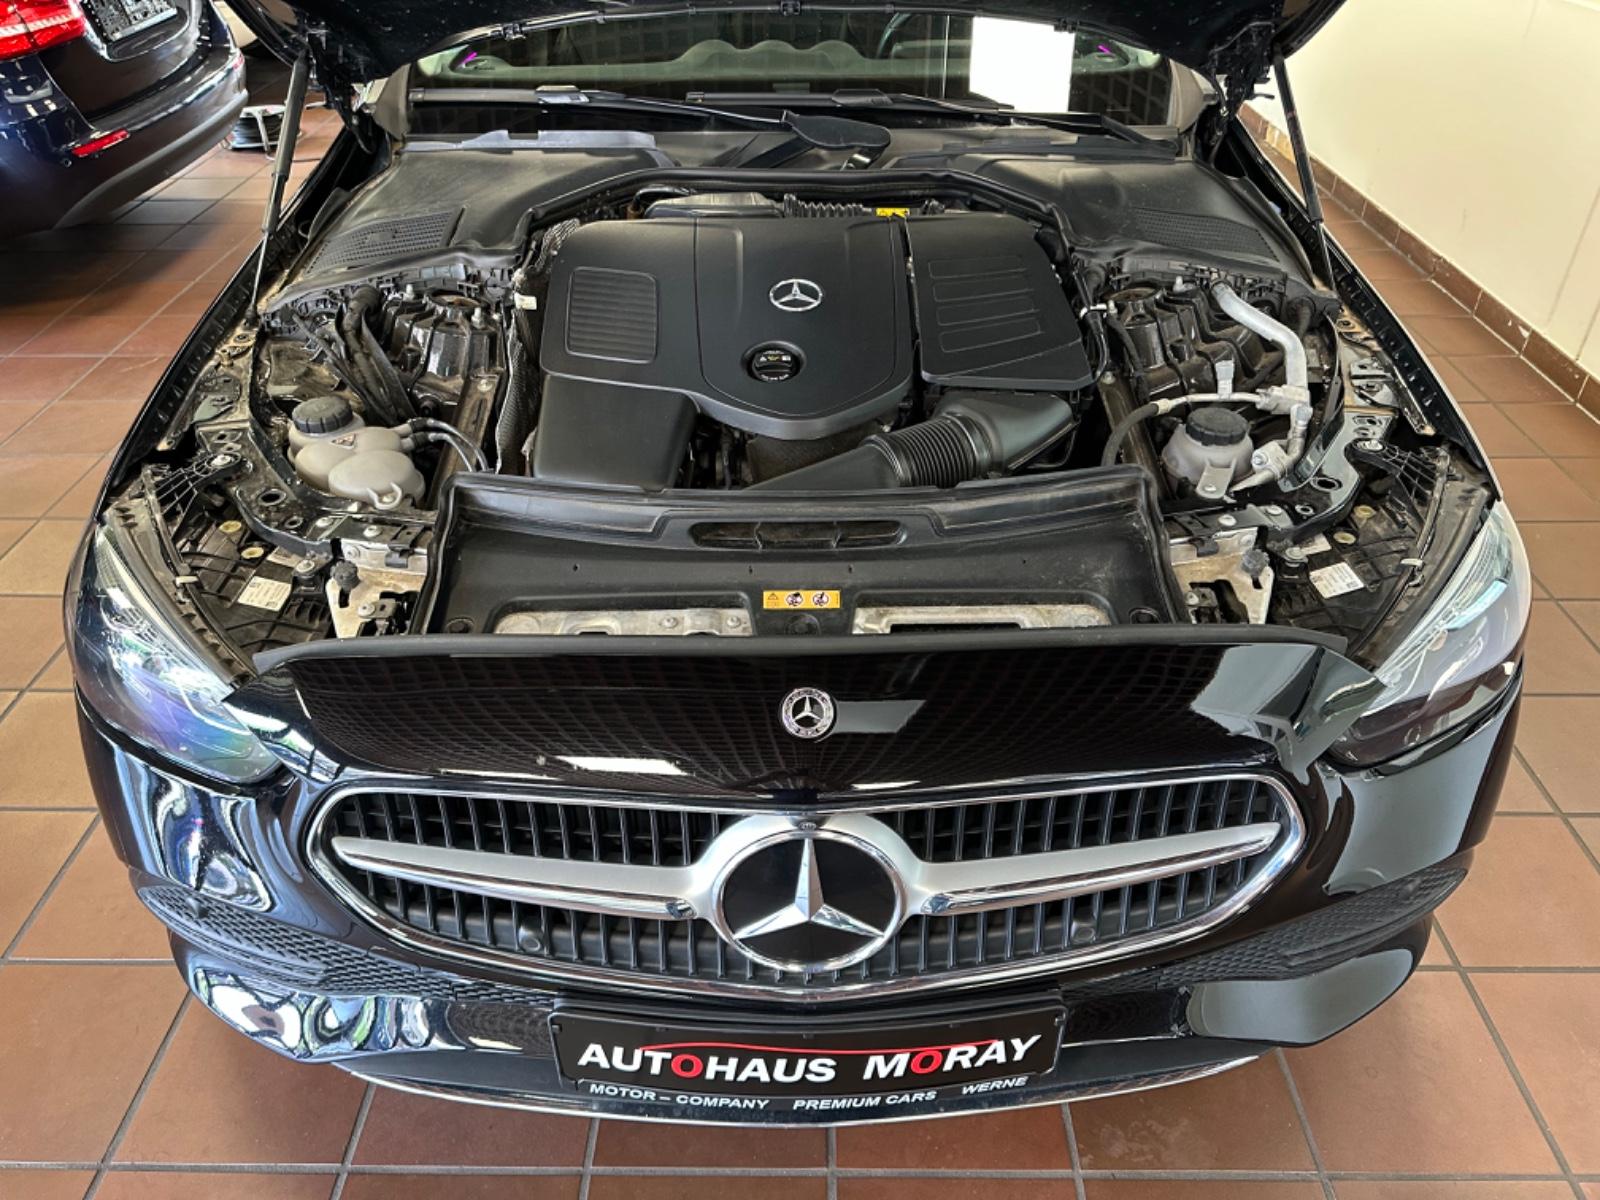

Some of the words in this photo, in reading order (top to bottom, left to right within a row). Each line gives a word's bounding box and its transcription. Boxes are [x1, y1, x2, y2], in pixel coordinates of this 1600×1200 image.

[577, 1043, 837, 1083] AUTOHAUS
[863, 1035, 1042, 1080] MORAY
[589, 1083, 656, 1102] MOTOR
[675, 1094, 770, 1110] COMPANY
[792, 1095, 881, 1111] PREMIUM
[885, 1090, 938, 1106] CARS
[961, 1075, 1029, 1096] WERNE
